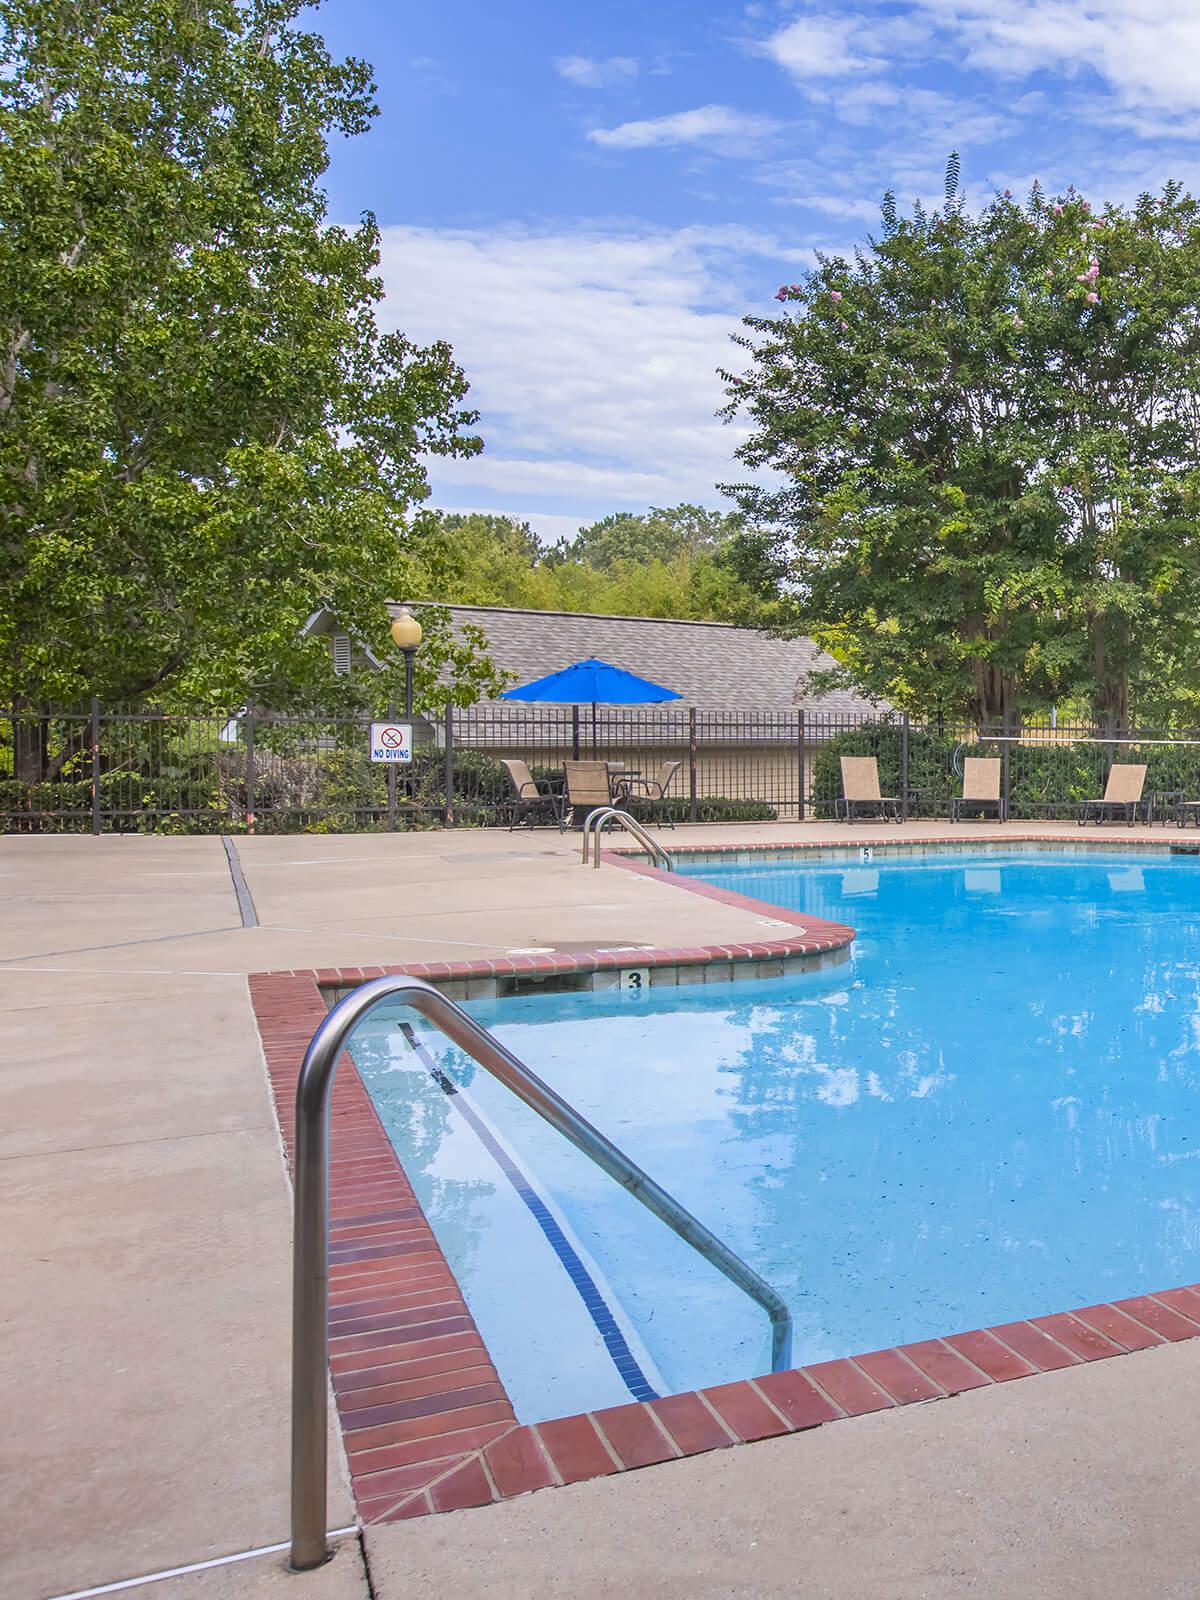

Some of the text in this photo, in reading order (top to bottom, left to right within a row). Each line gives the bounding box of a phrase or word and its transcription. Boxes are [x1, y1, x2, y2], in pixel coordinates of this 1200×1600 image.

[374, 749, 409, 759] NO DIVING
[864, 847, 869, 857] 5
[629, 972, 642, 989] 3
